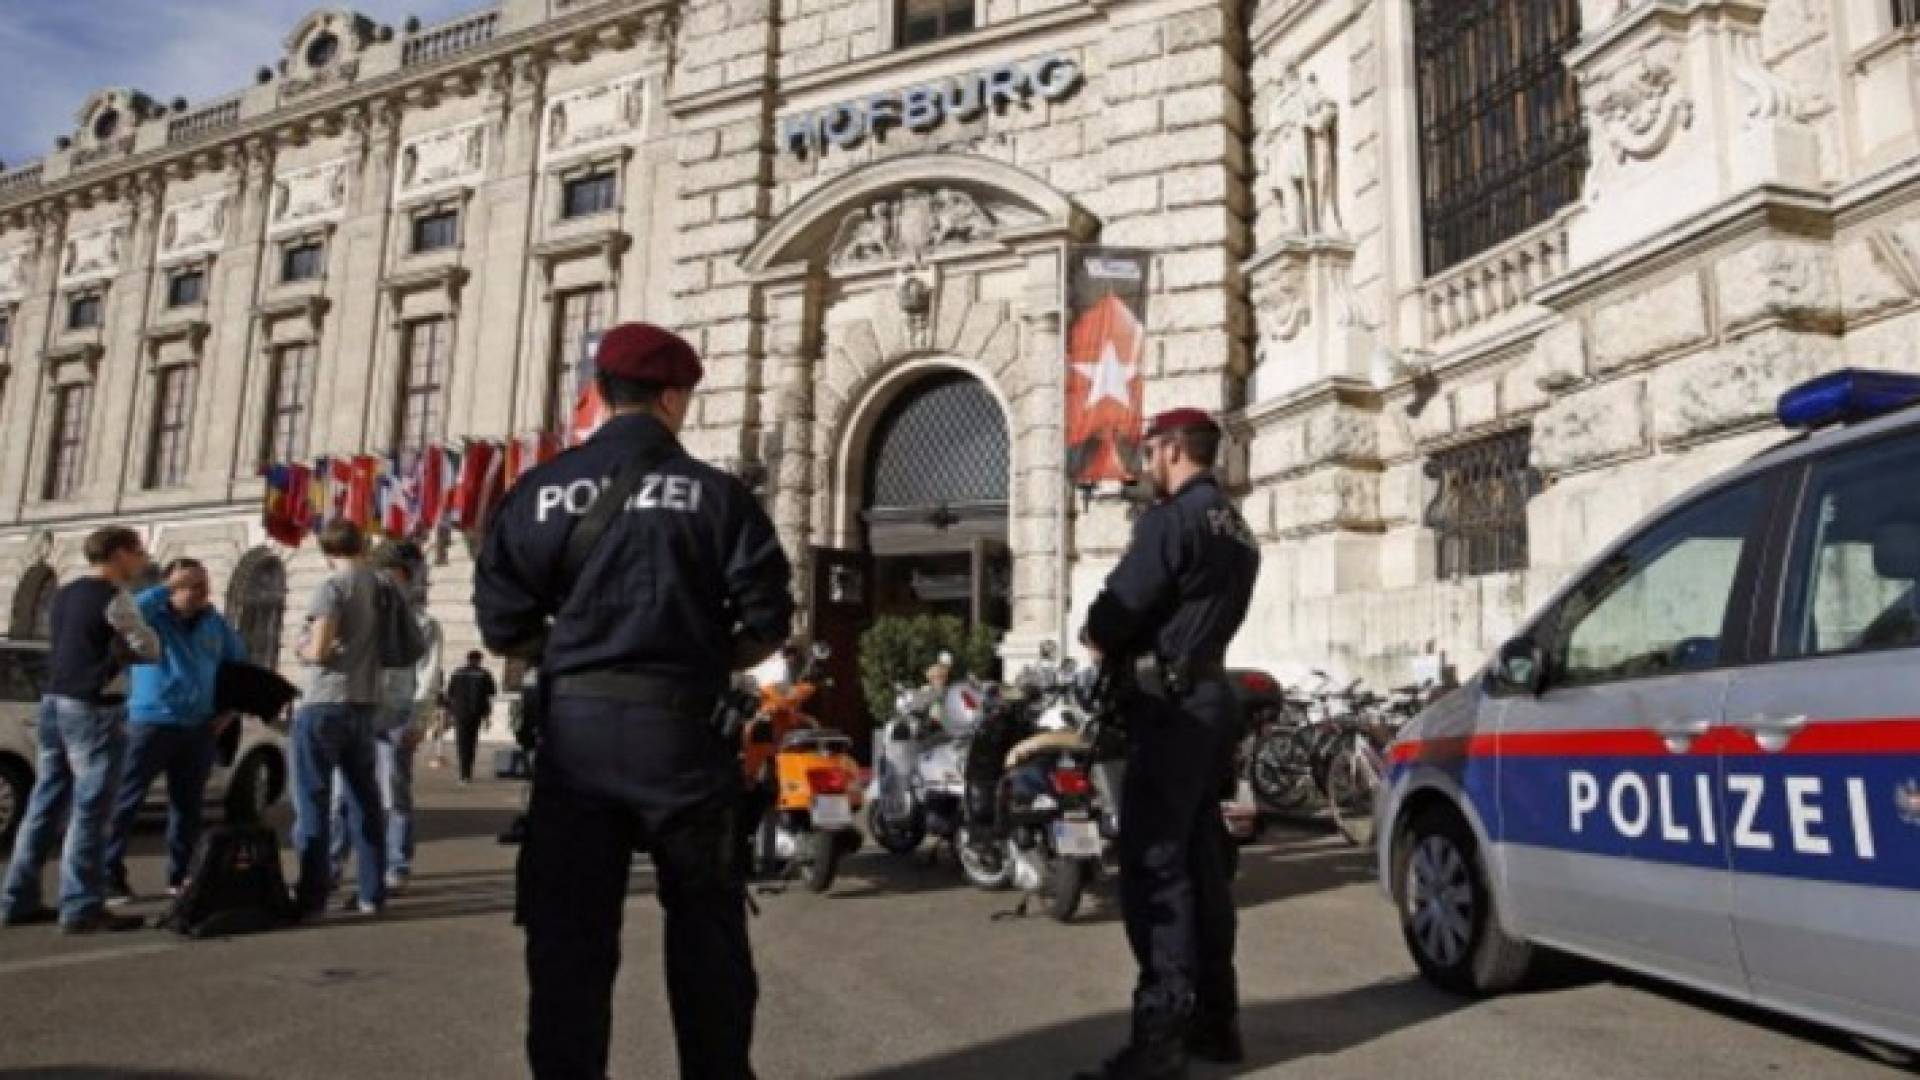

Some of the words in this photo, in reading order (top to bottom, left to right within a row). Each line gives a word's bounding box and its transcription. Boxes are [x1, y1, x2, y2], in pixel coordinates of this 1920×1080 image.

[781, 54, 1086, 157] HOFBURG
[536, 473, 702, 522] POZEI
[1568, 769, 1876, 860] POLIZEI
